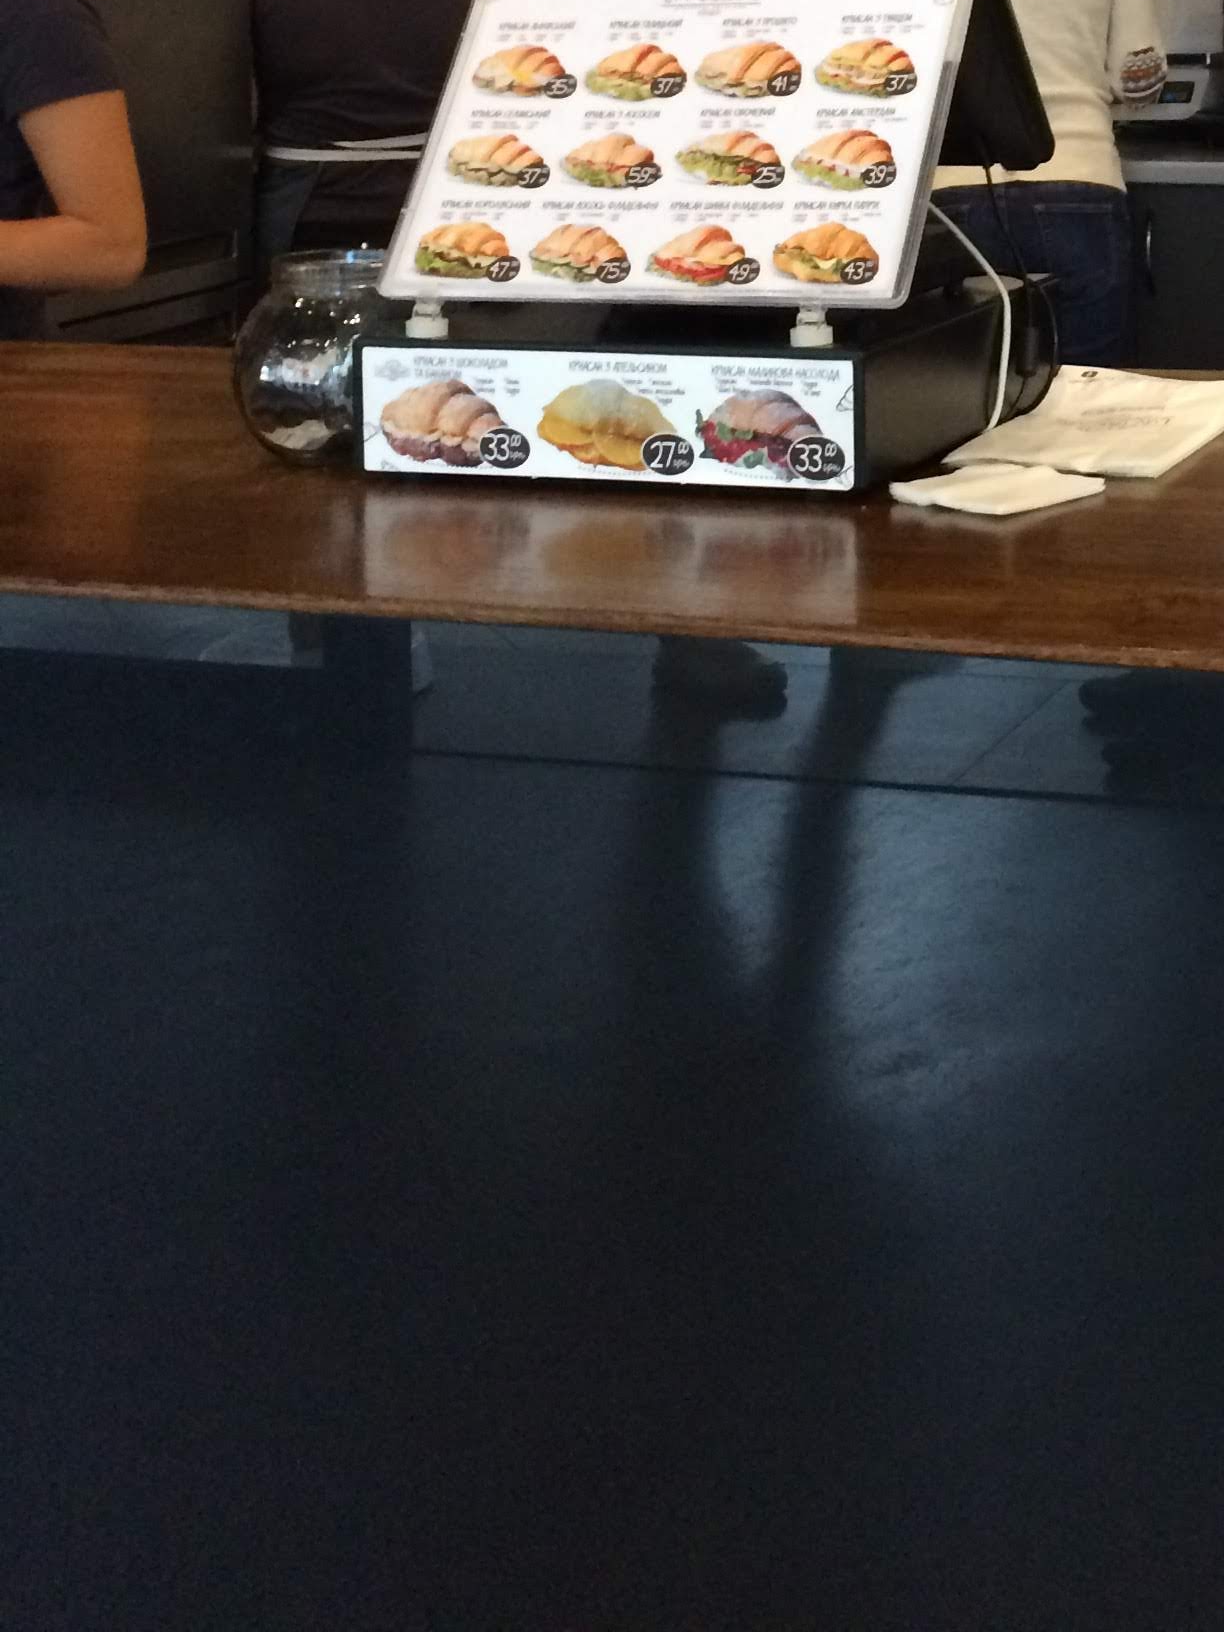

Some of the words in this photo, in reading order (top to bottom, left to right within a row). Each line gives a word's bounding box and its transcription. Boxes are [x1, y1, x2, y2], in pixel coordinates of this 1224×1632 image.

[520, 167, 541, 185] 37
[629, 166, 651, 184] 59
[753, 167, 777, 184] 25
[865, 167, 888, 185] 39
[488, 260, 509, 280] 47
[599, 261, 621, 279] 75
[728, 263, 752, 281] 49
[844, 261, 866, 280] 43
[484, 432, 510, 461] 33
[649, 441, 676, 468] 27
[794, 444, 823, 472] 33
